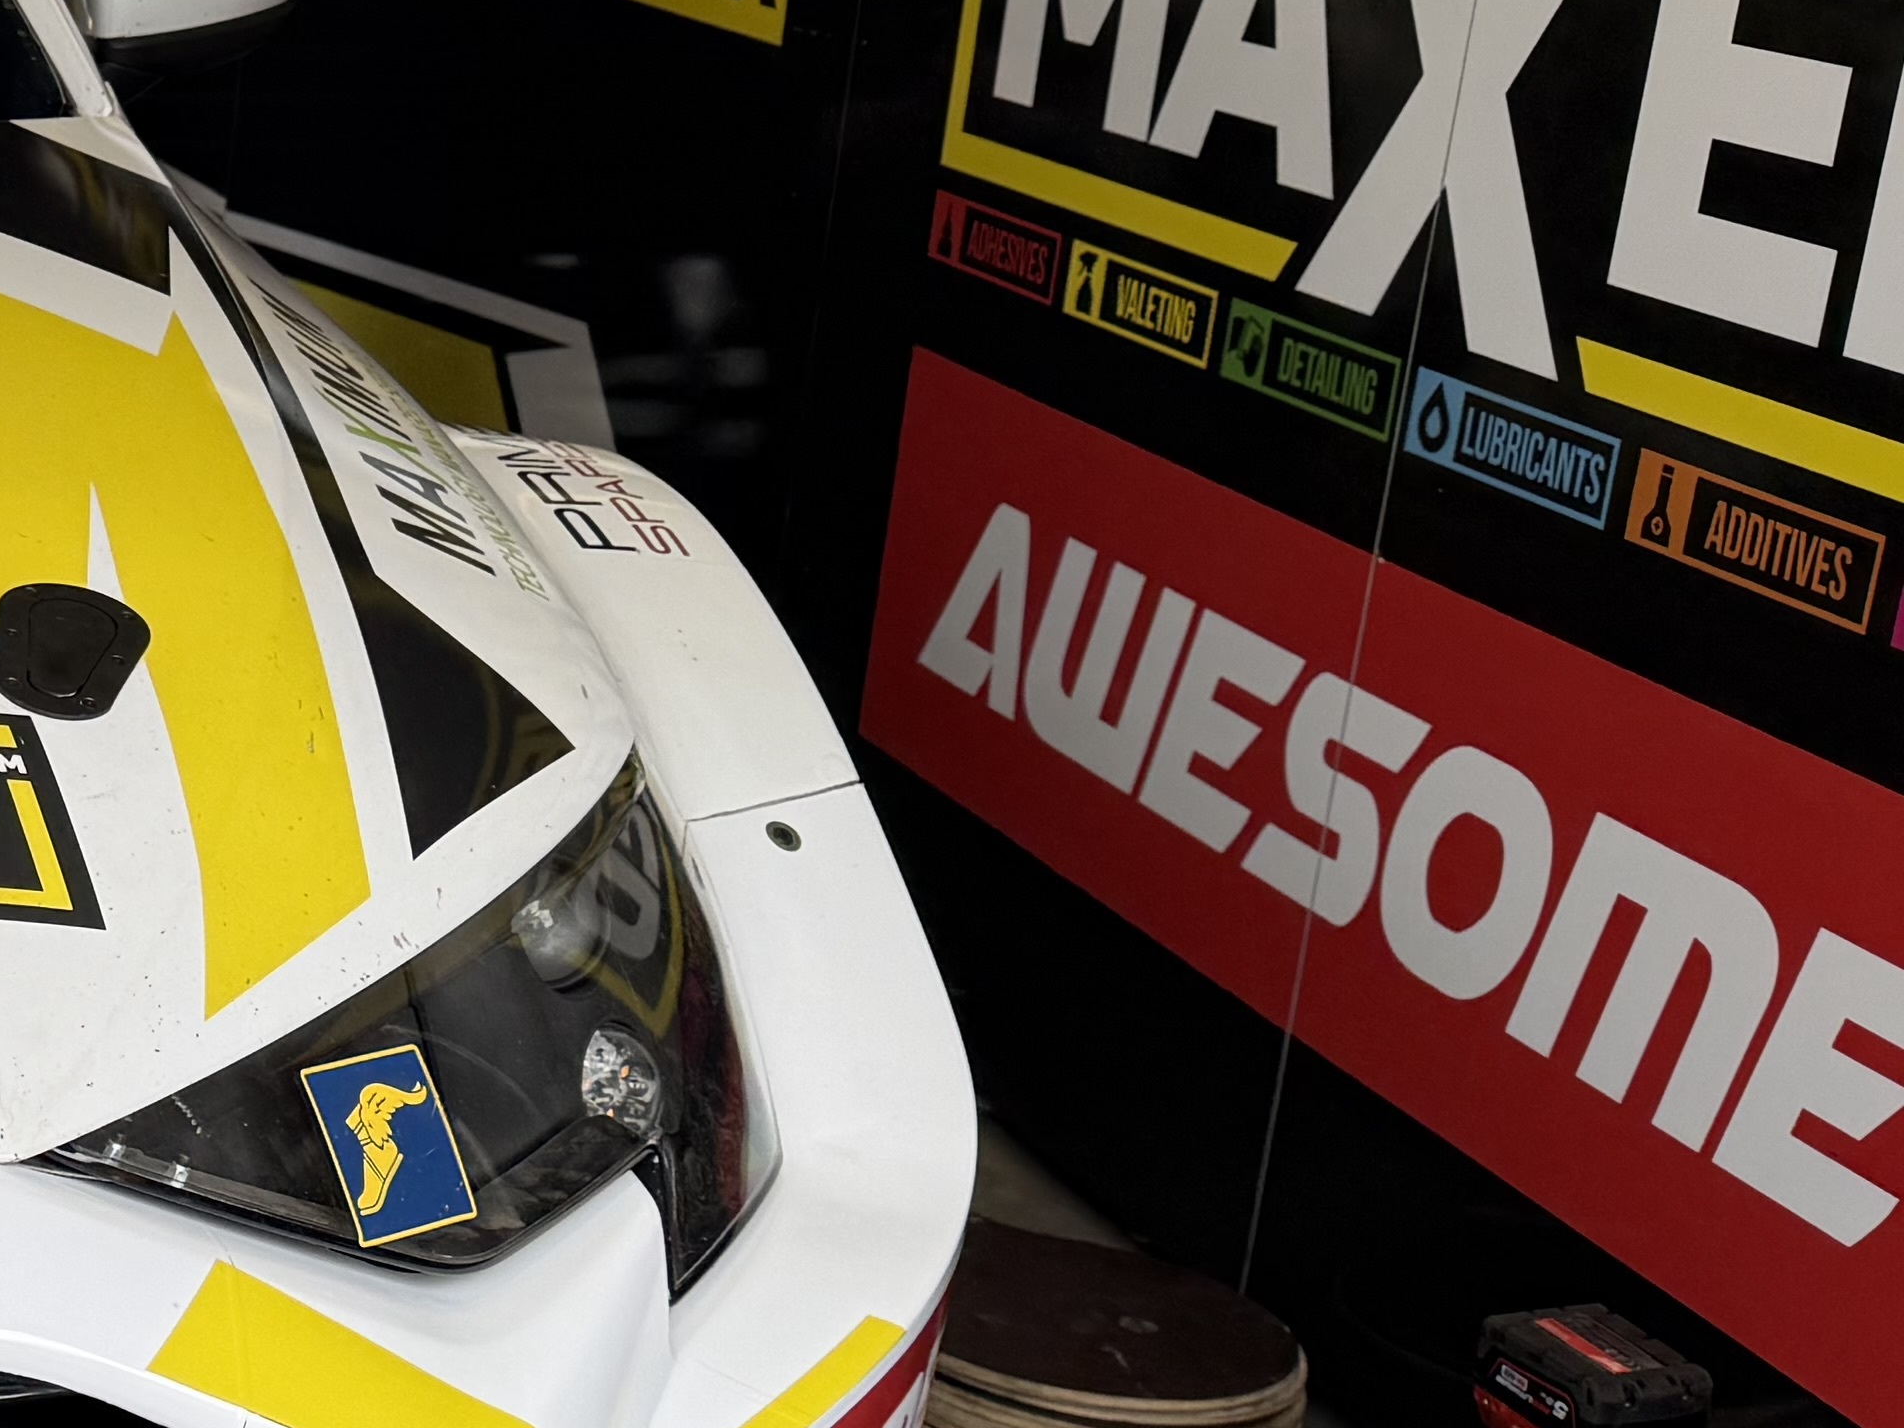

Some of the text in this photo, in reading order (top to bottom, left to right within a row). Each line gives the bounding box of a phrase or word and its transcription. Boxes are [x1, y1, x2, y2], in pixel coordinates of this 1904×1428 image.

[965, 218, 1046, 285] ADHESIVES
[1115, 274, 1196, 346] VALETING
[1277, 333, 1377, 415] DETAILING
[1462, 404, 1607, 505] LUBRICANTS
[1705, 502, 1853, 601] ADDITIVES
[916, 502, 1904, 1246] AWESOME
